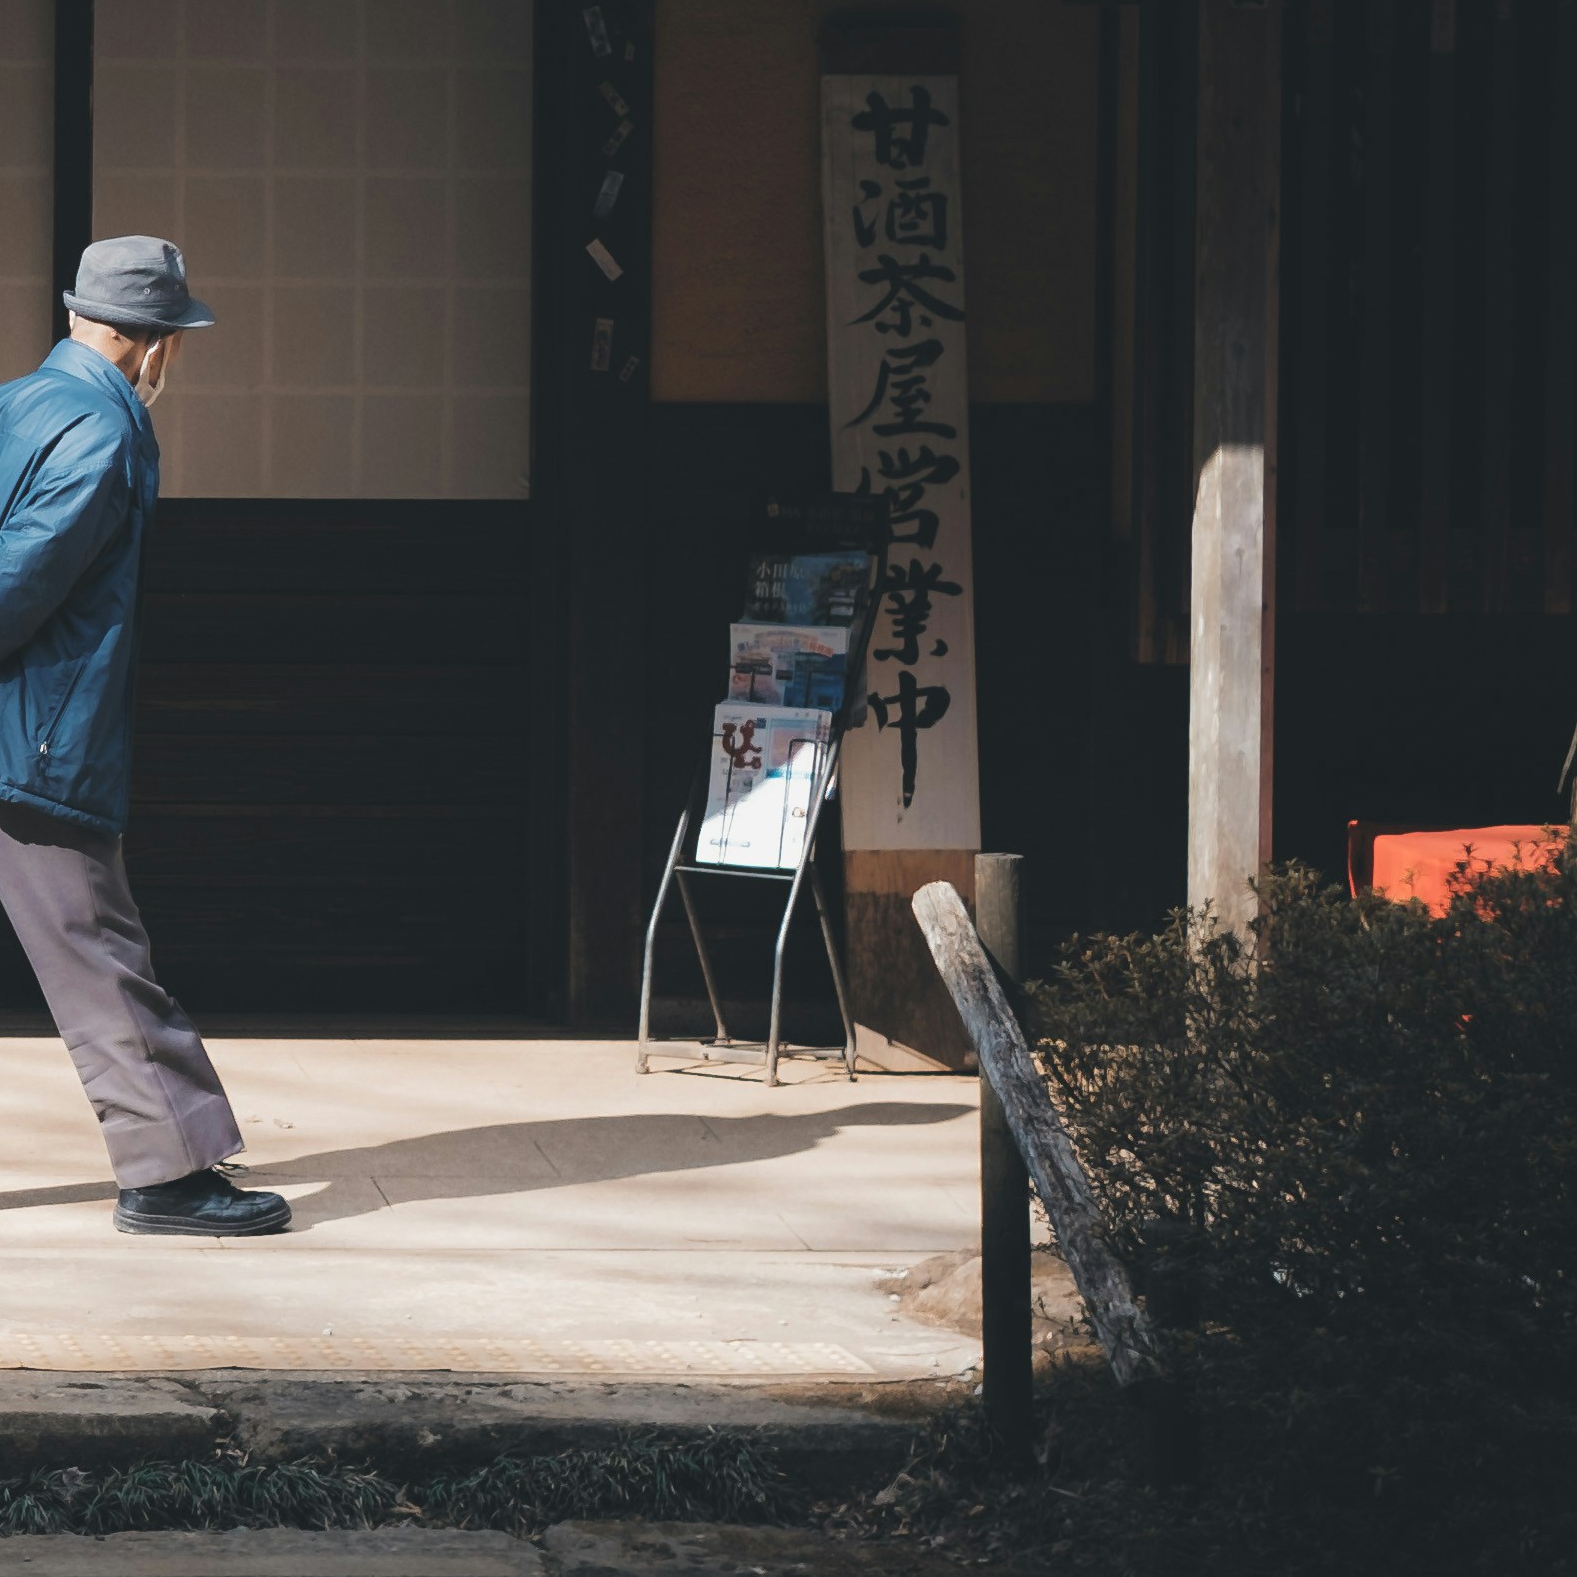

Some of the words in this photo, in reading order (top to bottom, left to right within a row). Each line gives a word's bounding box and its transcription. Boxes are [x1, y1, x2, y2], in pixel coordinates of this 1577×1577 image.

[846, 86, 967, 810] 甘酒茶屋営業中
